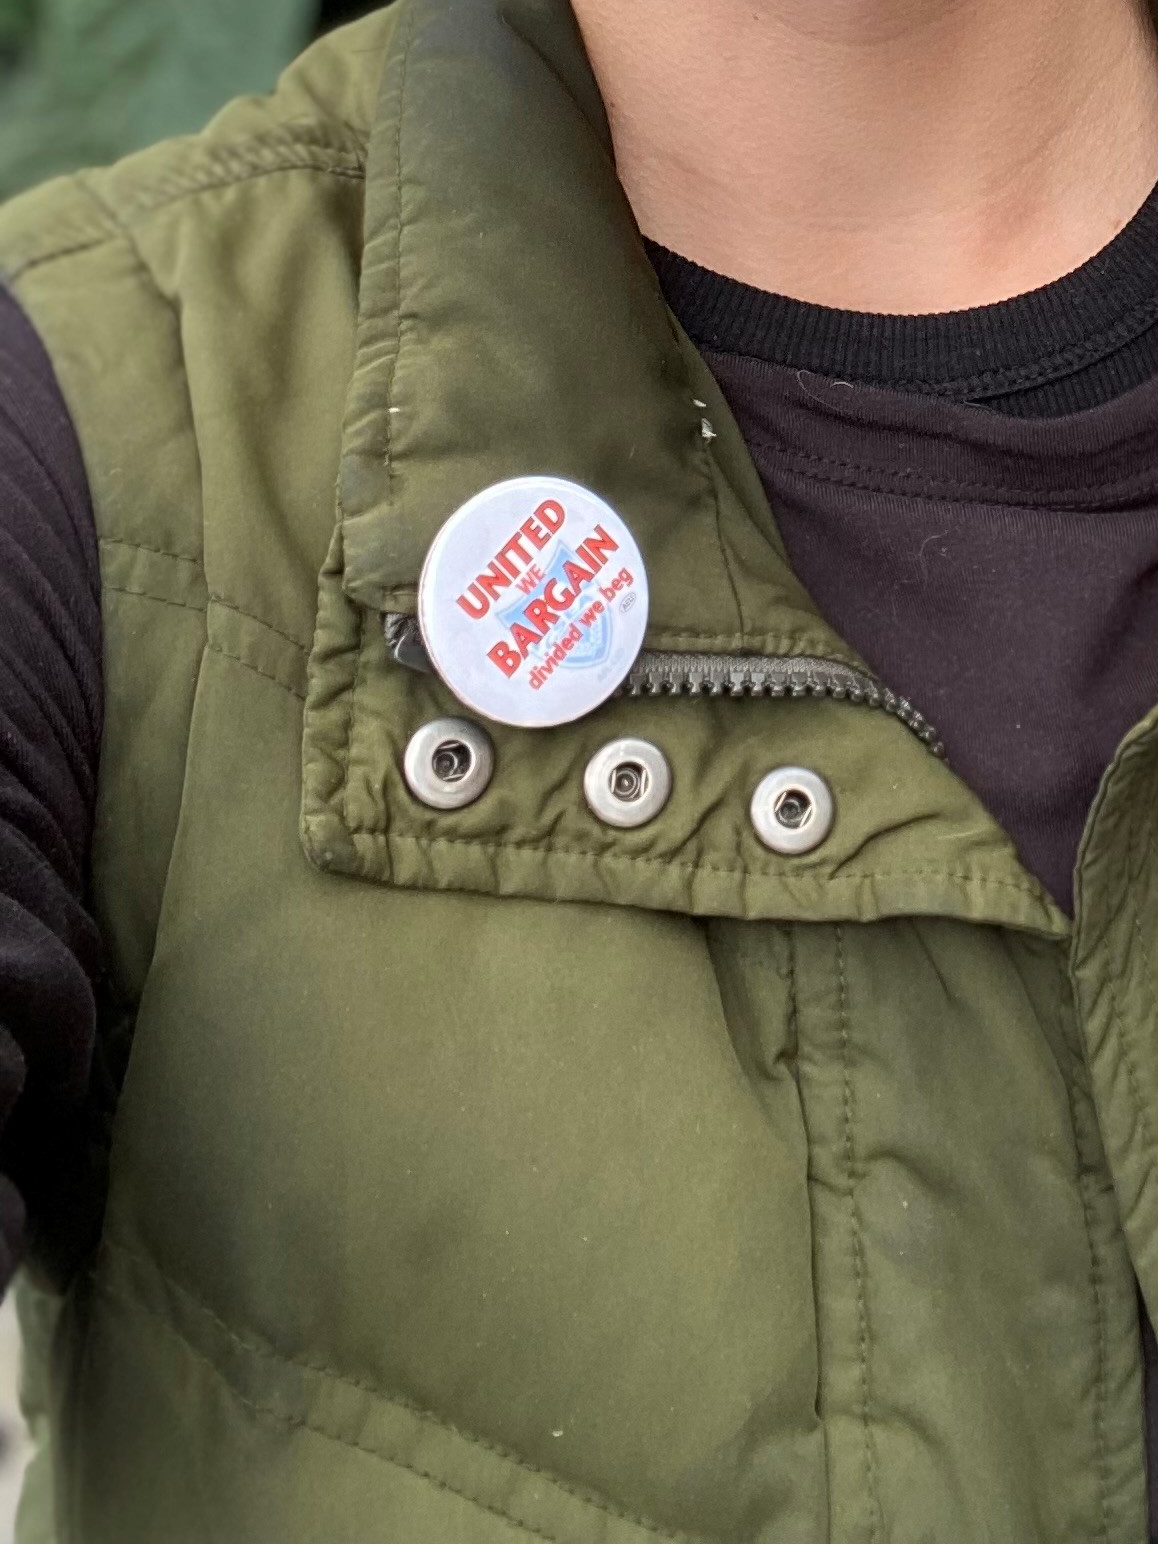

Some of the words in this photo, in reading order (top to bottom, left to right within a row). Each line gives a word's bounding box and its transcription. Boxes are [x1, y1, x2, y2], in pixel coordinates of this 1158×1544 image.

[455, 499, 566, 620] UNITED
[487, 524, 619, 679] BARGAIN
[515, 564, 546, 595] WE
[528, 623, 583, 690] divided
[579, 599, 605, 628] we
[599, 568, 634, 602] beg
